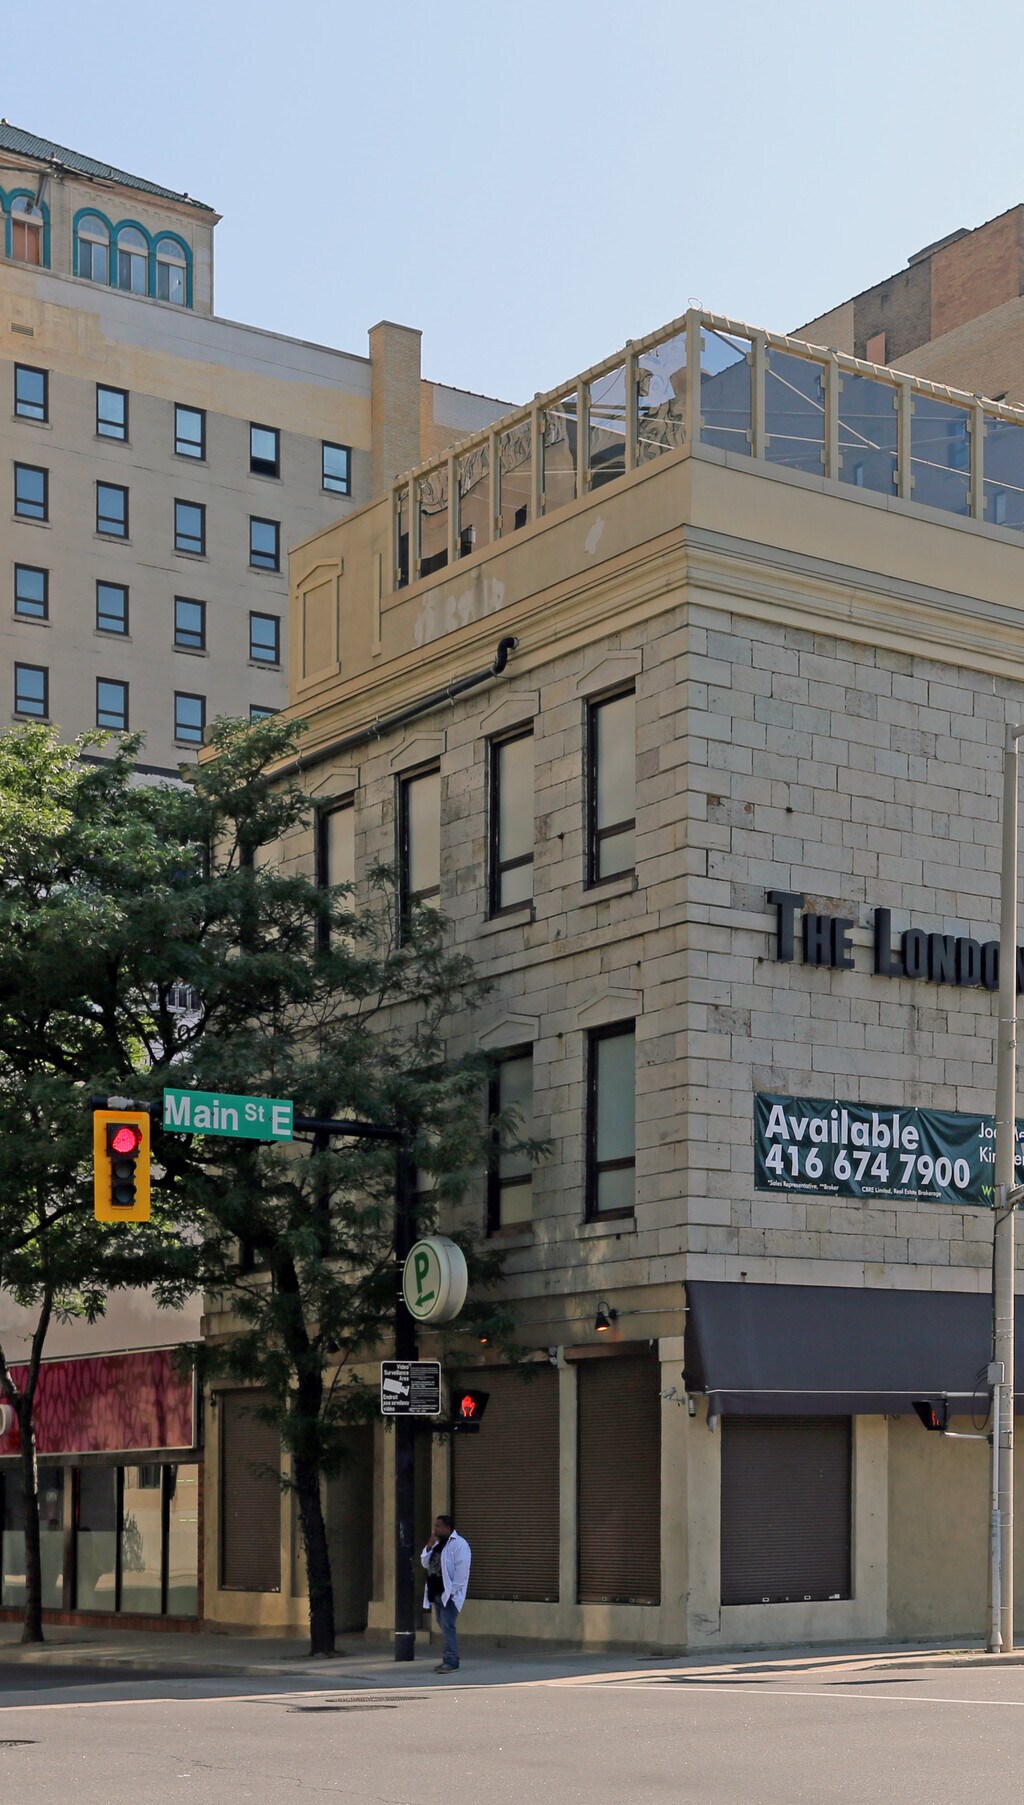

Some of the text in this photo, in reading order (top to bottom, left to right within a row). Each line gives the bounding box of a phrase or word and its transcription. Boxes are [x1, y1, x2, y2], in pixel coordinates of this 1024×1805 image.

[165, 1094, 291, 1136] Main St E
[764, 1105, 920, 1150] Available
[764, 1144, 824, 1179] 416
[833, 1150, 890, 1183] 674
[899, 1154, 971, 1189] 7900
[414, 1251, 430, 1295] P
